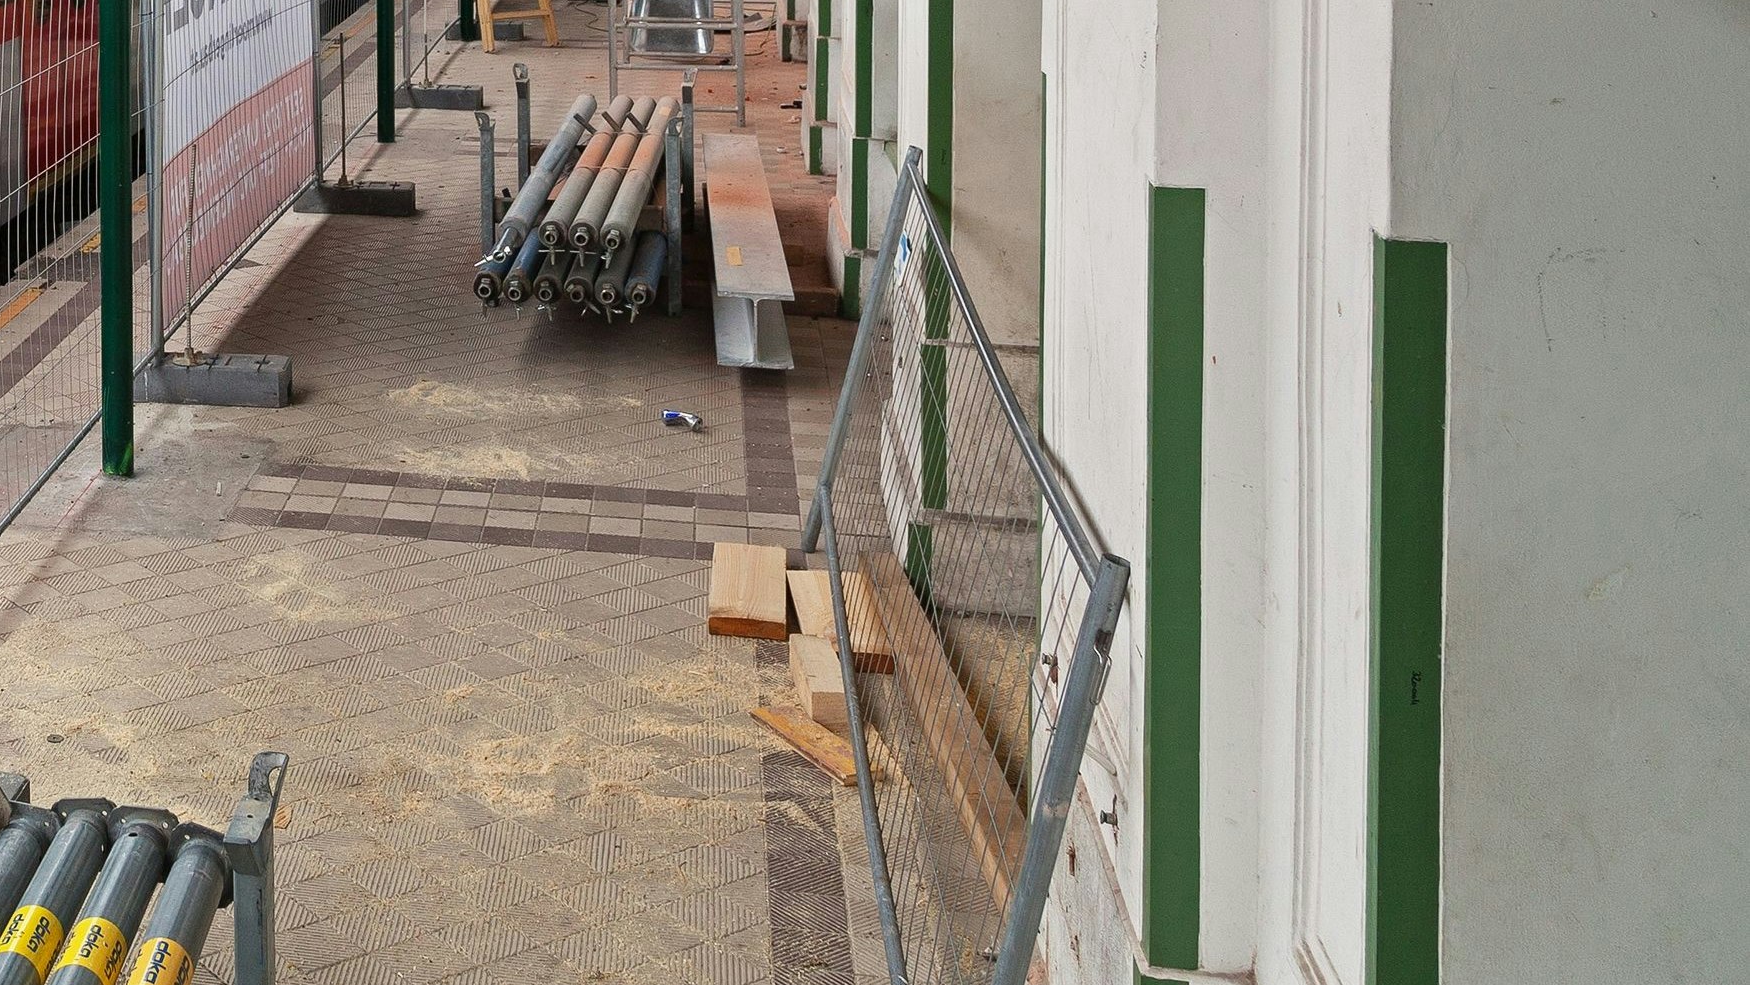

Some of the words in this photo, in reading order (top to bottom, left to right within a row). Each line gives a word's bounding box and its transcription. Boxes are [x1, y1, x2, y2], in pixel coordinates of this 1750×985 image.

[26, 916, 51, 953] doka
[78, 924, 104, 958] doka
[143, 940, 171, 985] doka
